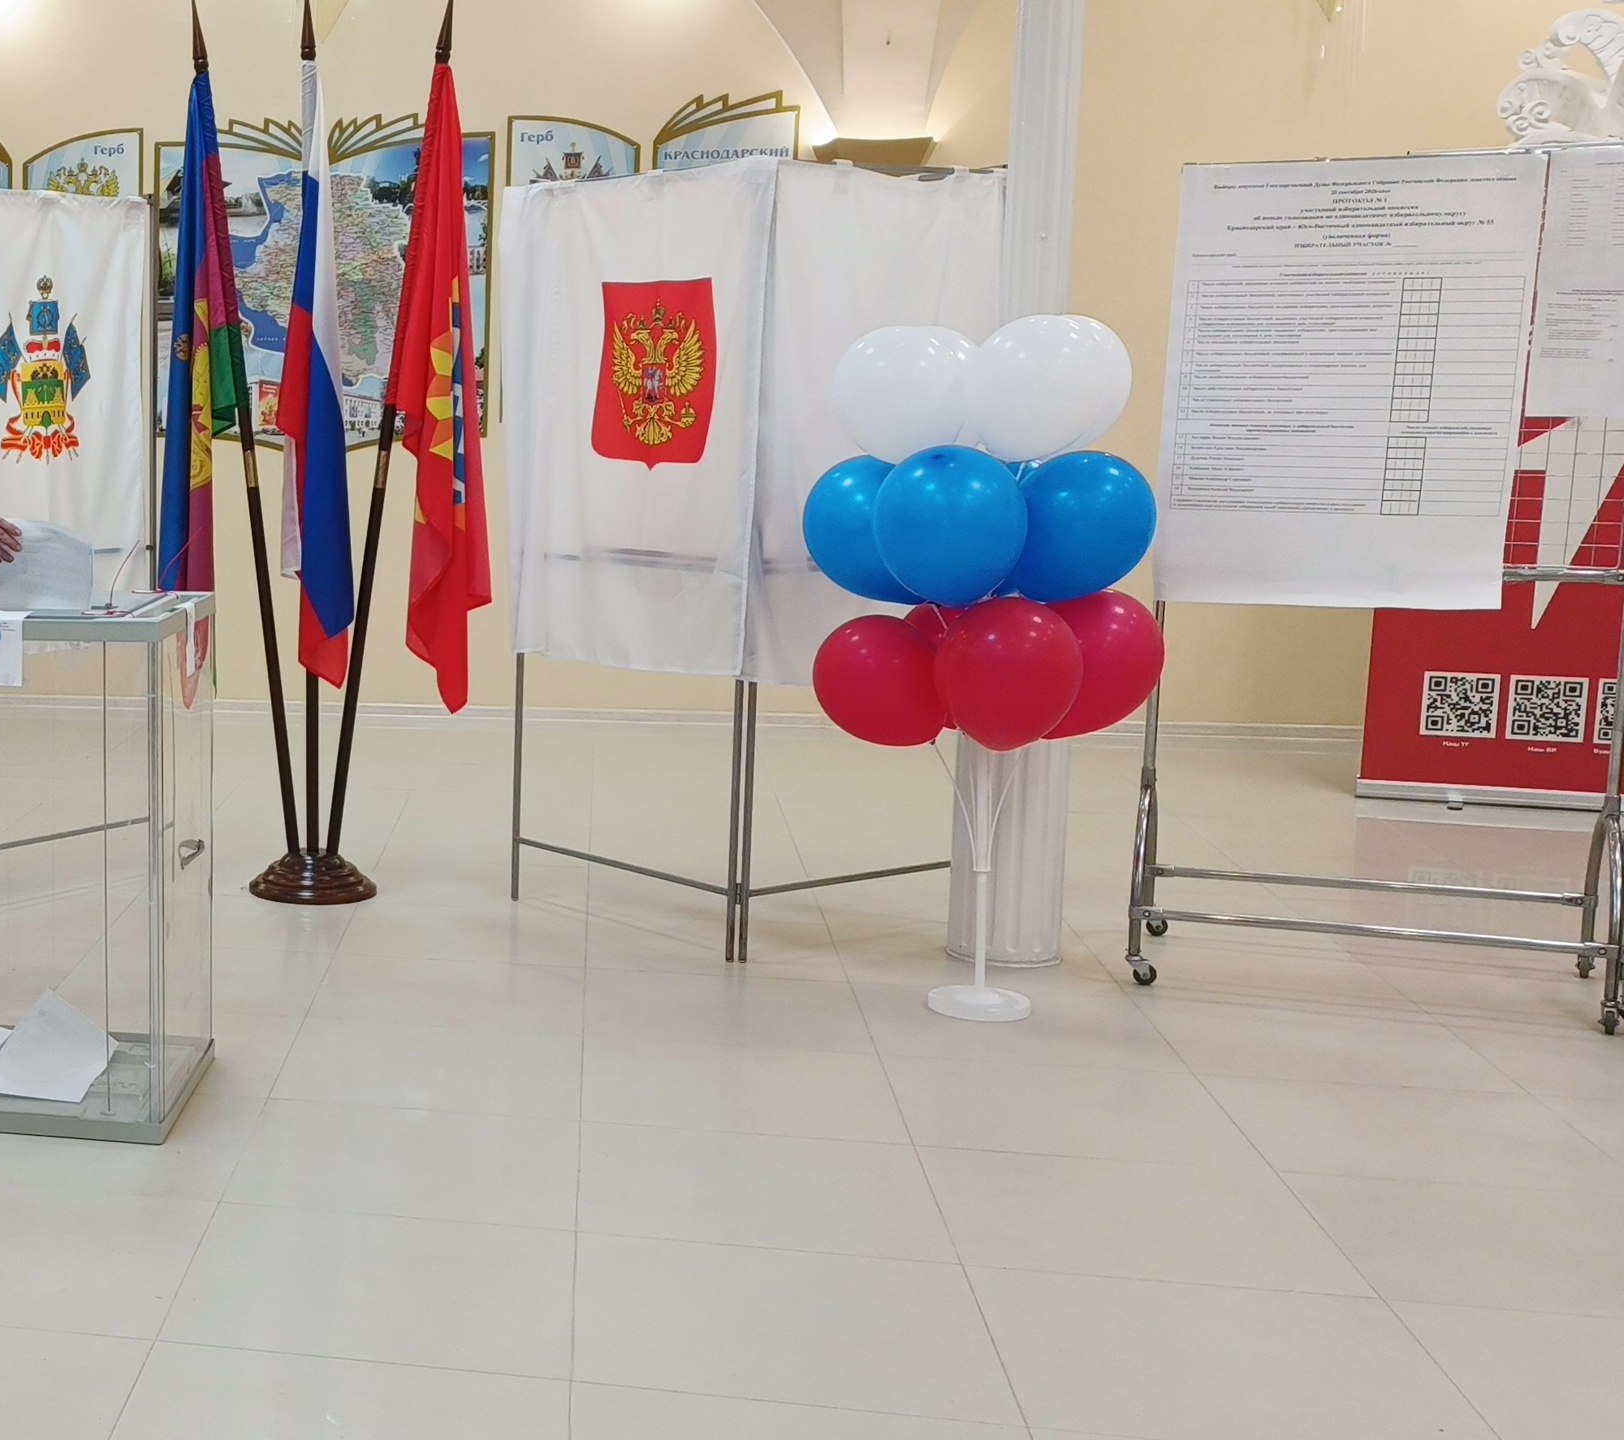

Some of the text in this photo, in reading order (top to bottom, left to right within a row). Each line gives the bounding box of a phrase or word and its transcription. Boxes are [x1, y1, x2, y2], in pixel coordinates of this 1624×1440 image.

[520, 130, 554, 144] Герб
[93, 143, 125, 157] Герб
[664, 146, 789, 160] КРАСНОДАРСКИЙ
